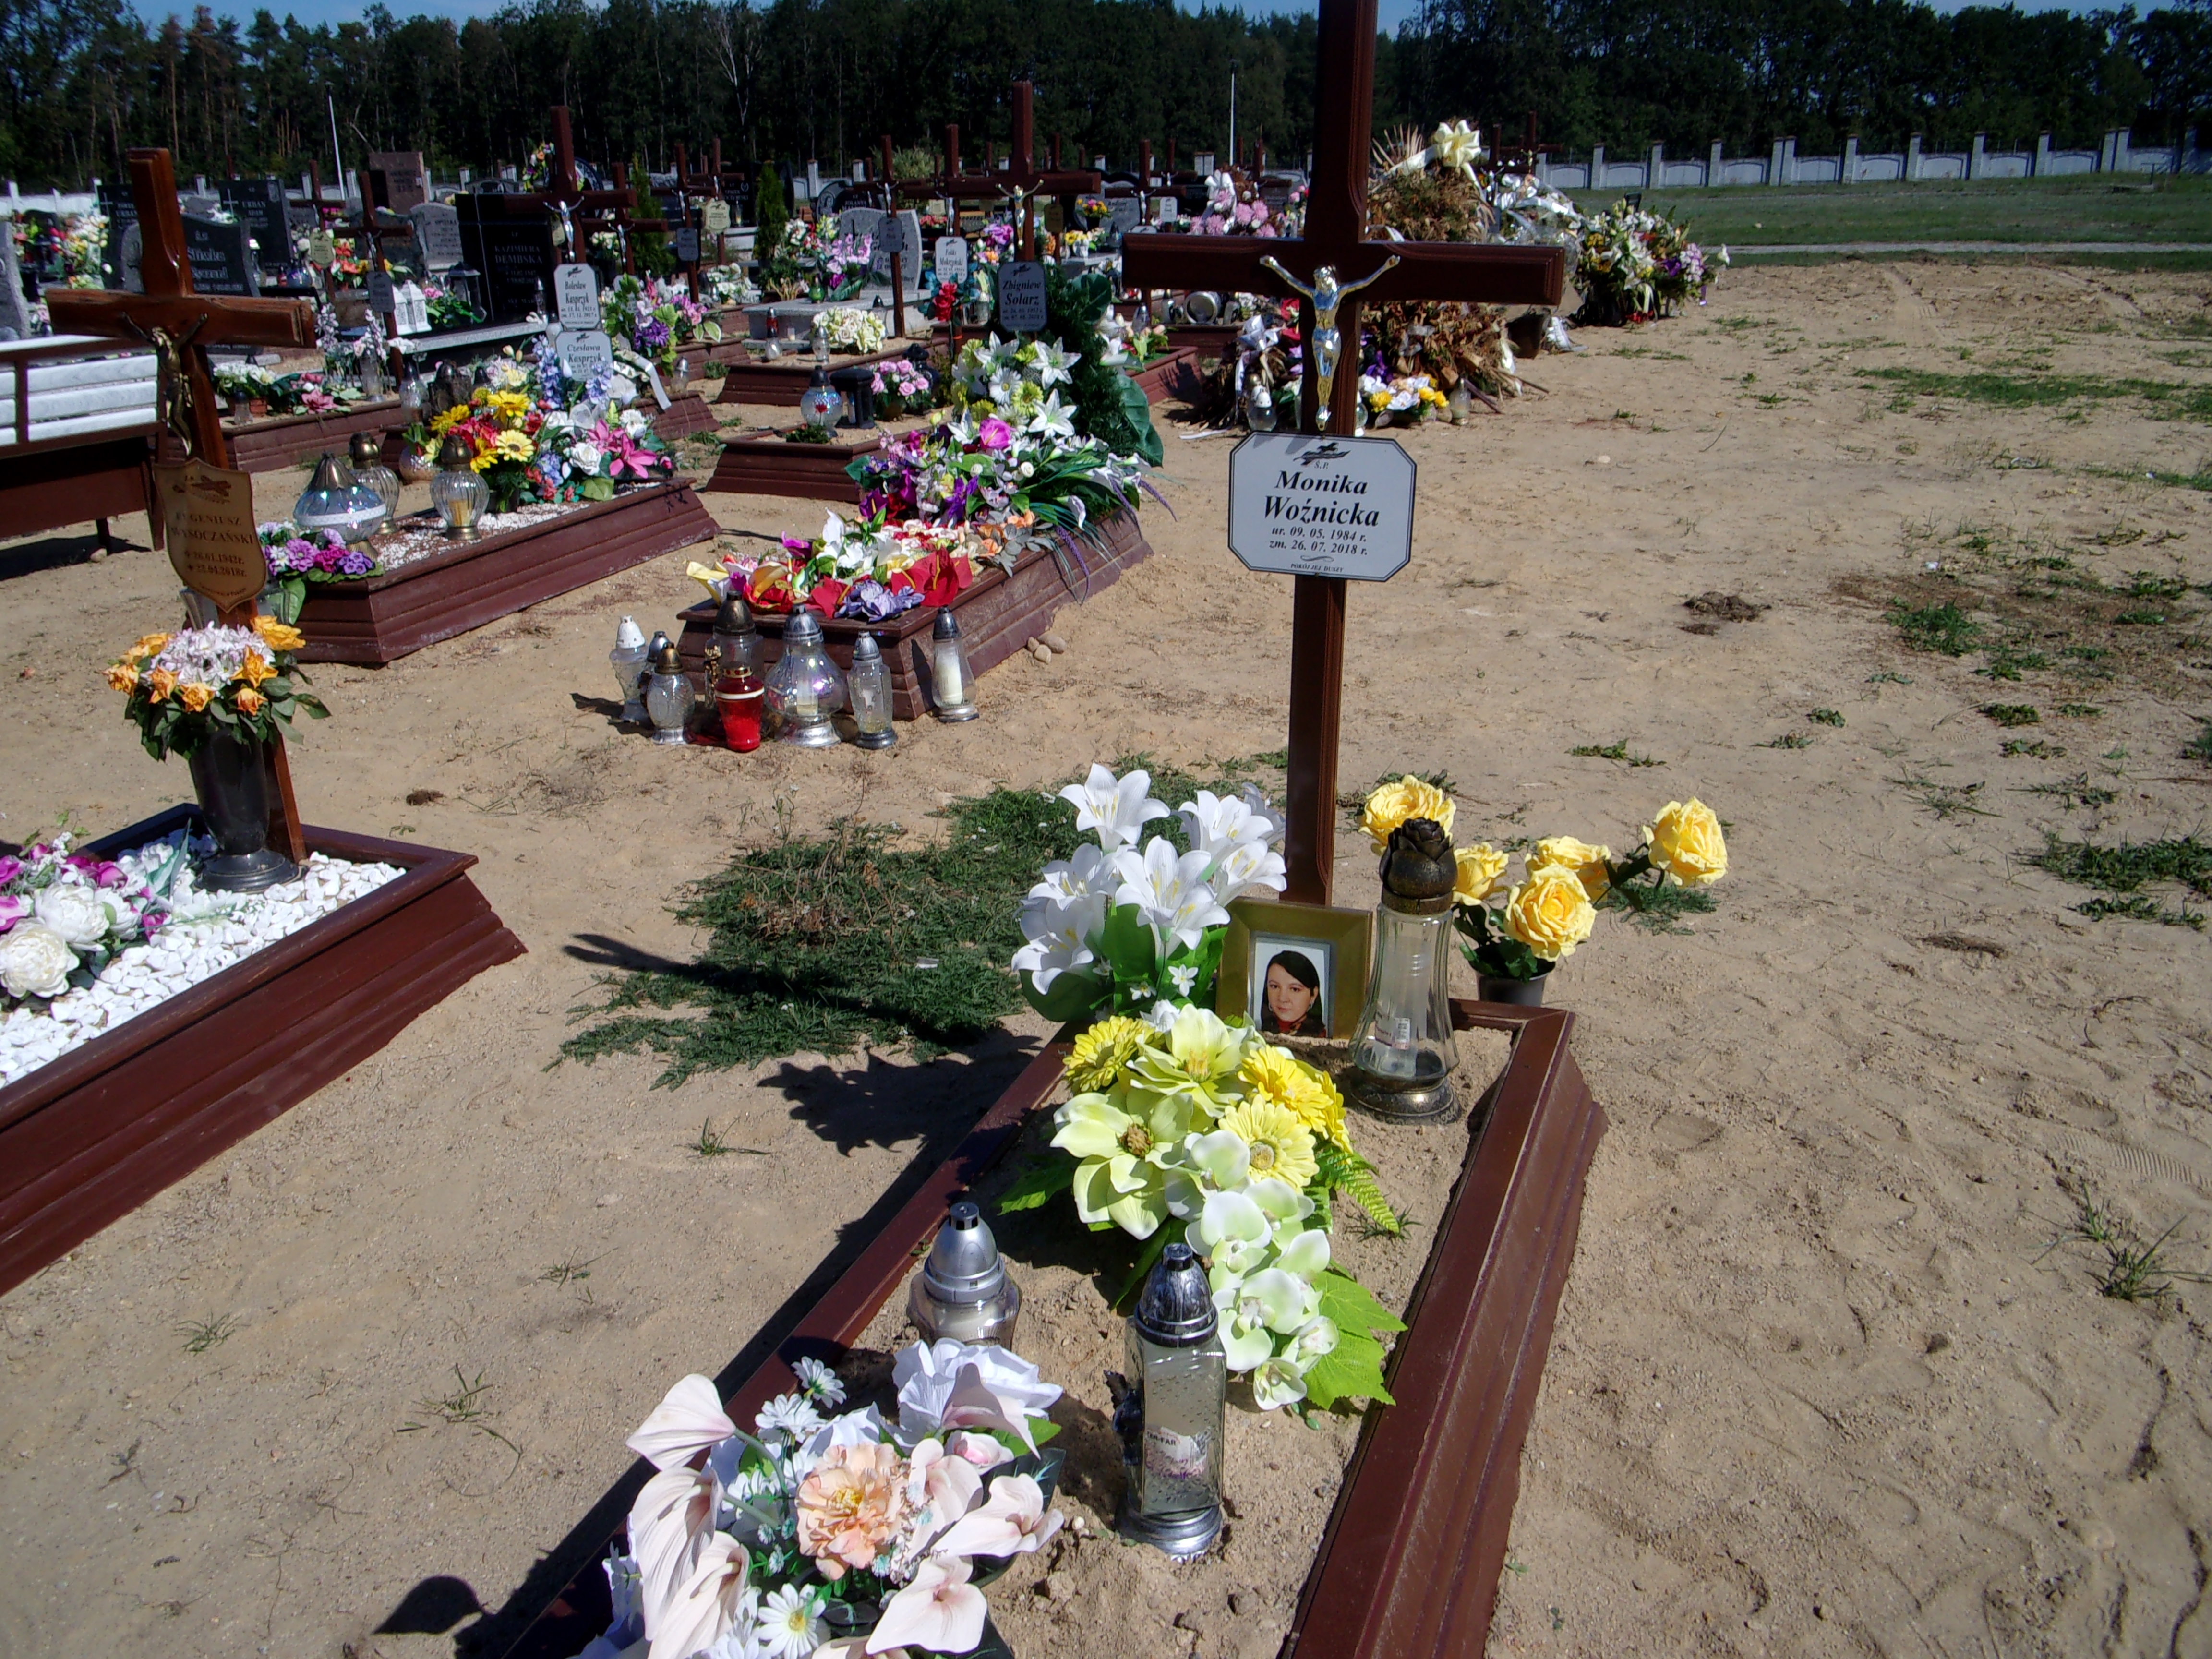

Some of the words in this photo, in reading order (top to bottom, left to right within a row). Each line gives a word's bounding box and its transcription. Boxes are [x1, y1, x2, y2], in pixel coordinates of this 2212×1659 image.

[1002, 279, 1041, 292] Zbigniew
[1005, 292, 1039, 305] Solarz
[568, 353, 602, 366] Kasprzyk
[1274, 470, 1368, 495] Monika
[1264, 495, 1380, 527] Woźnicka
[176, 512, 241, 526] EUGENIUSZ
[1272, 527, 1286, 536] ur.
[1290, 526, 1305, 537] 09.
[1310, 528, 1325, 539] 05.
[1330, 529, 1357, 541] 1984
[1359, 534, 1367, 542] r.
[1269, 540, 1287, 549] zm.
[1291, 540, 1307, 551] 26.
[1311, 541, 1326, 553] 07.
[1330, 542, 1358, 555] 2018
[1360, 547, 1368, 556] r.
